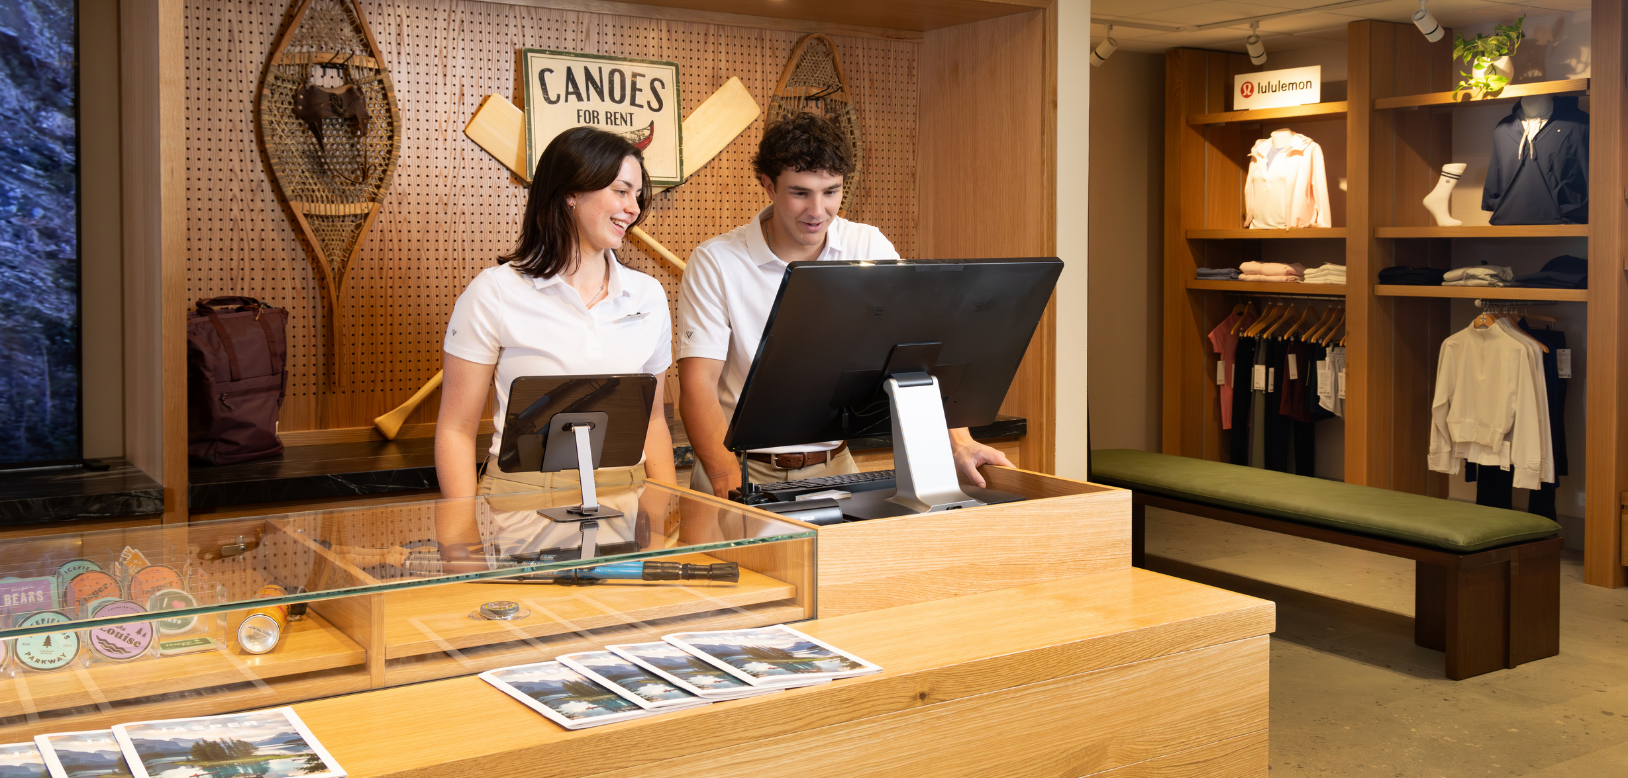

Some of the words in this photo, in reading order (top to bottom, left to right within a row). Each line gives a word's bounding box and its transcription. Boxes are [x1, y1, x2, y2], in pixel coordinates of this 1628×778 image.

[538, 66, 666, 113] CANOES
[1257, 80, 1313, 94] lululemon
[576, 109, 600, 125] FOR
[605, 111, 635, 127] RENT
[3, 590, 44, 606] BEARS
[24, 652, 67, 665] PARKWAY
